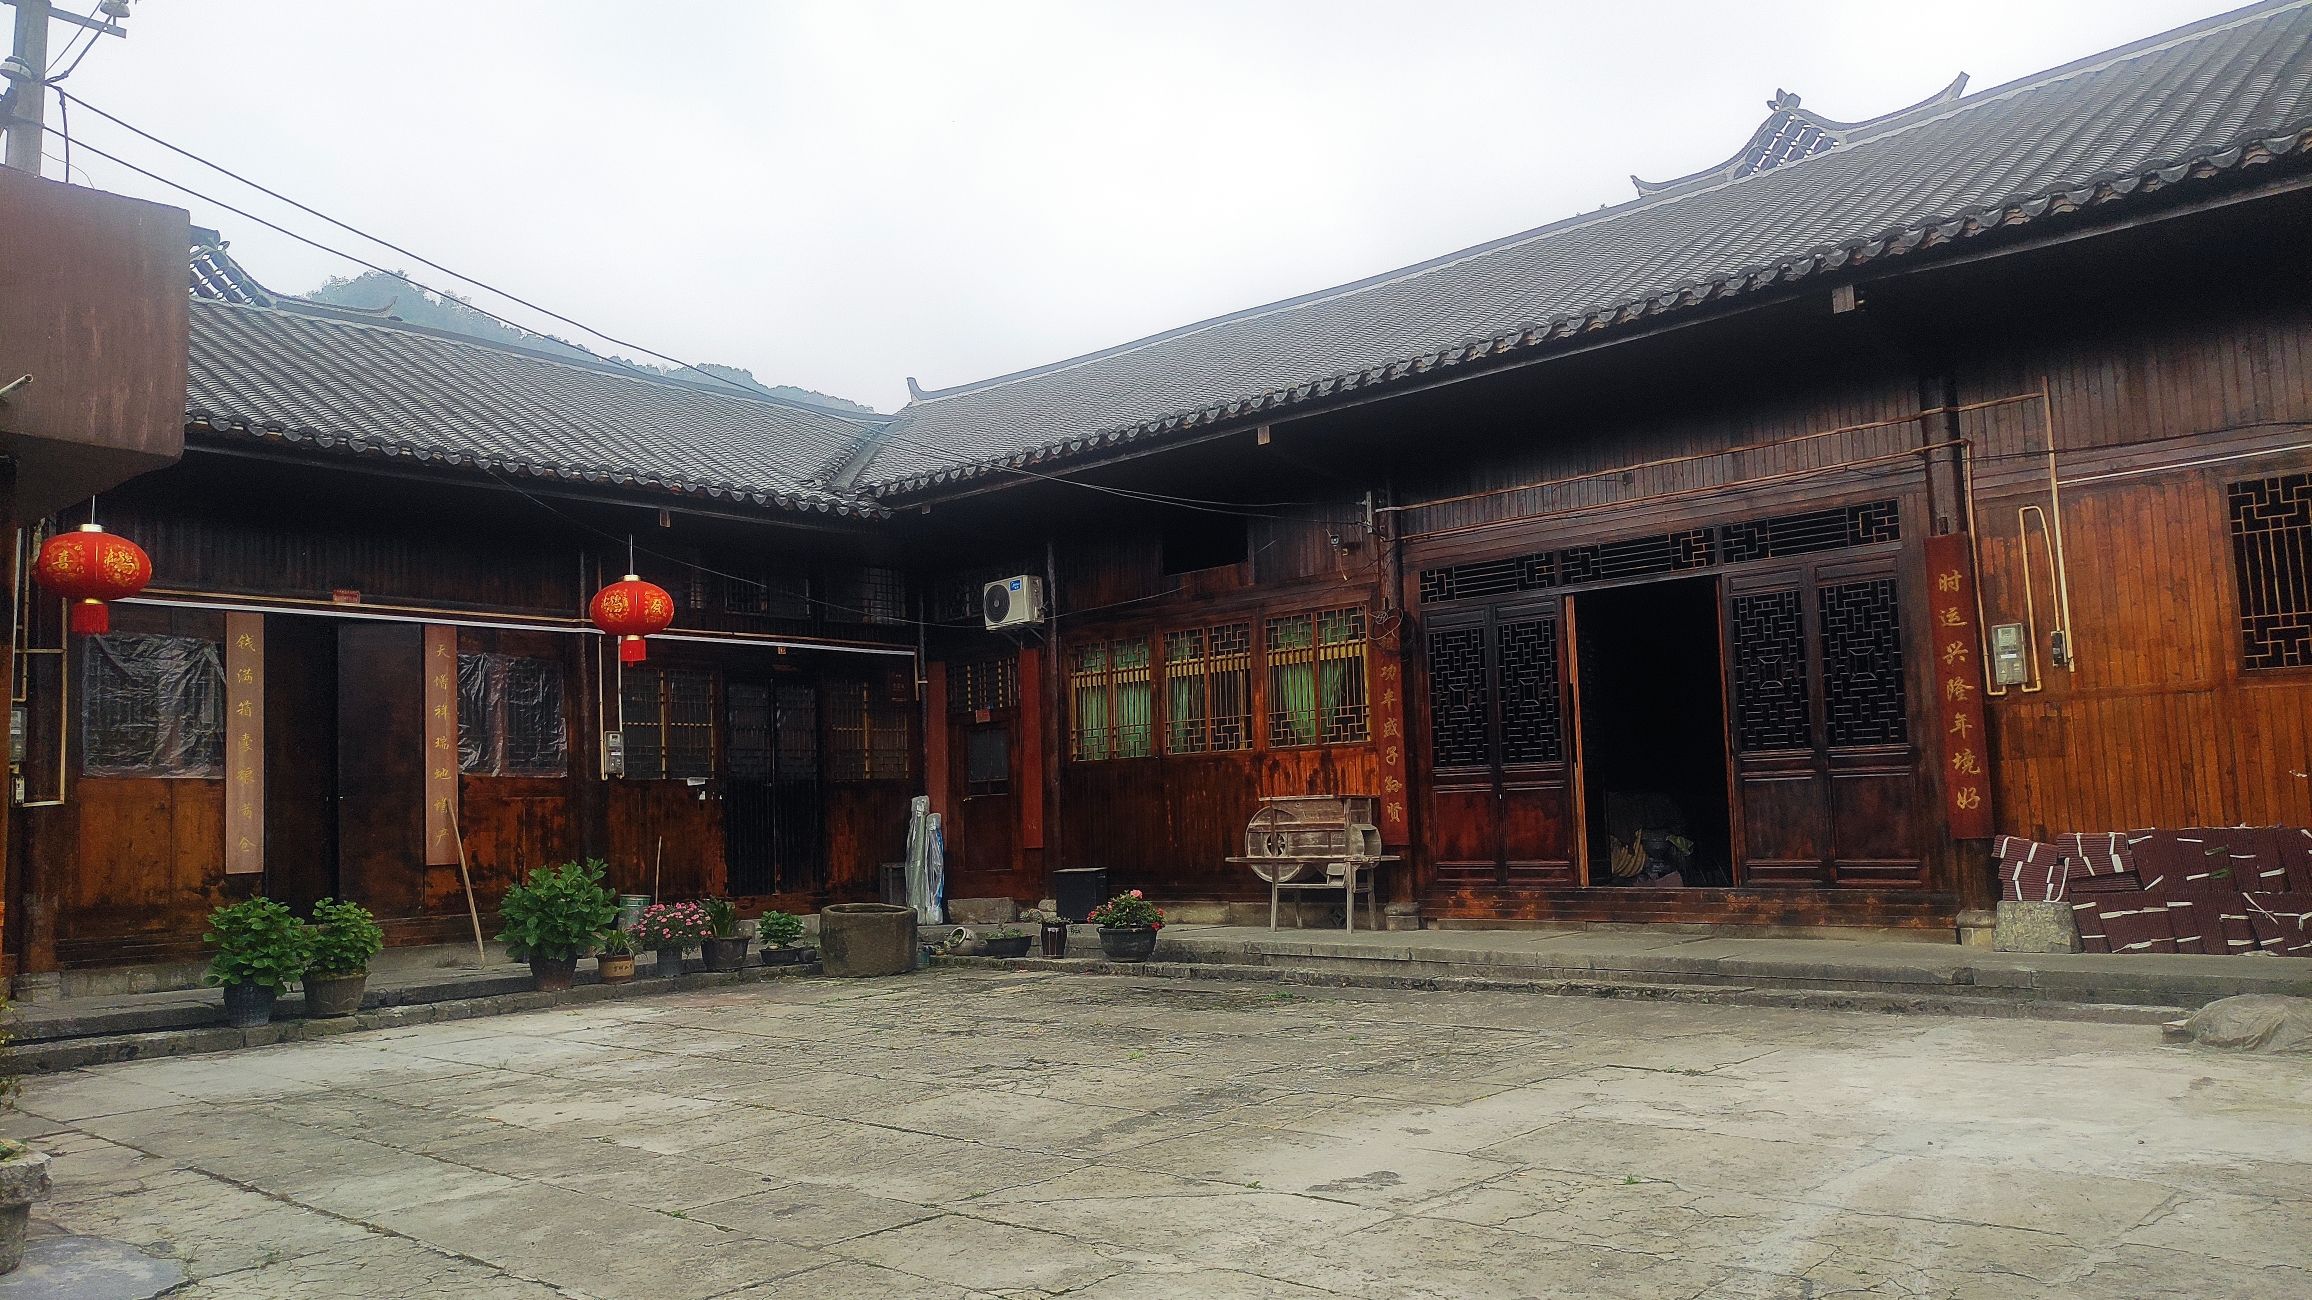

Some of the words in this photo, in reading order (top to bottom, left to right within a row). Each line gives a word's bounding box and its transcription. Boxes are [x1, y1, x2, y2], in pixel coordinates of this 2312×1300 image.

[1937, 568, 1982, 811] 时运兴隆年境好
